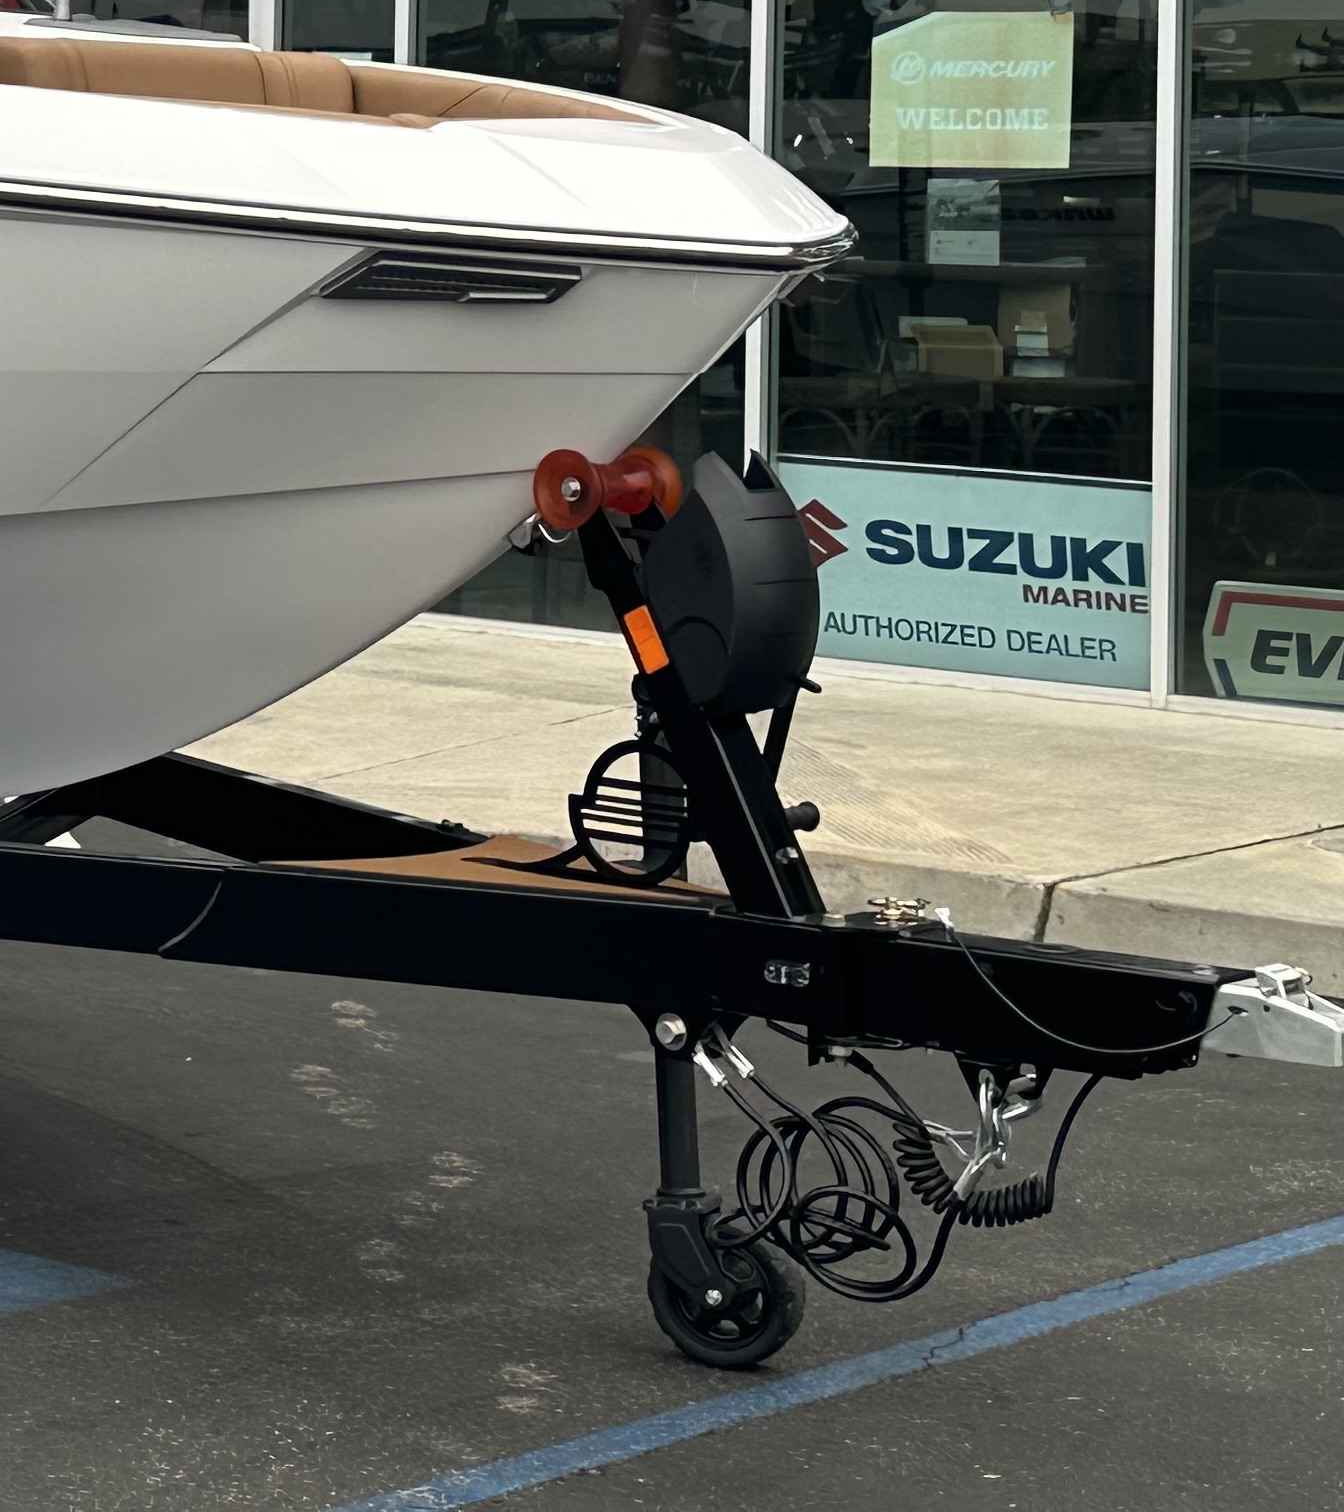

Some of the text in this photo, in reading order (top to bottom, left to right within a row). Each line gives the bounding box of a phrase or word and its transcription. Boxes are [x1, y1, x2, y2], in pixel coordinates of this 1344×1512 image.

[927, 59, 1057, 79] MERCURY
[896, 107, 1050, 132] WELCOME
[864, 518, 1146, 588] SUZUKI
[1022, 583, 1149, 614] MARINE
[824, 610, 1117, 662] AUTHORIZED DEALER
